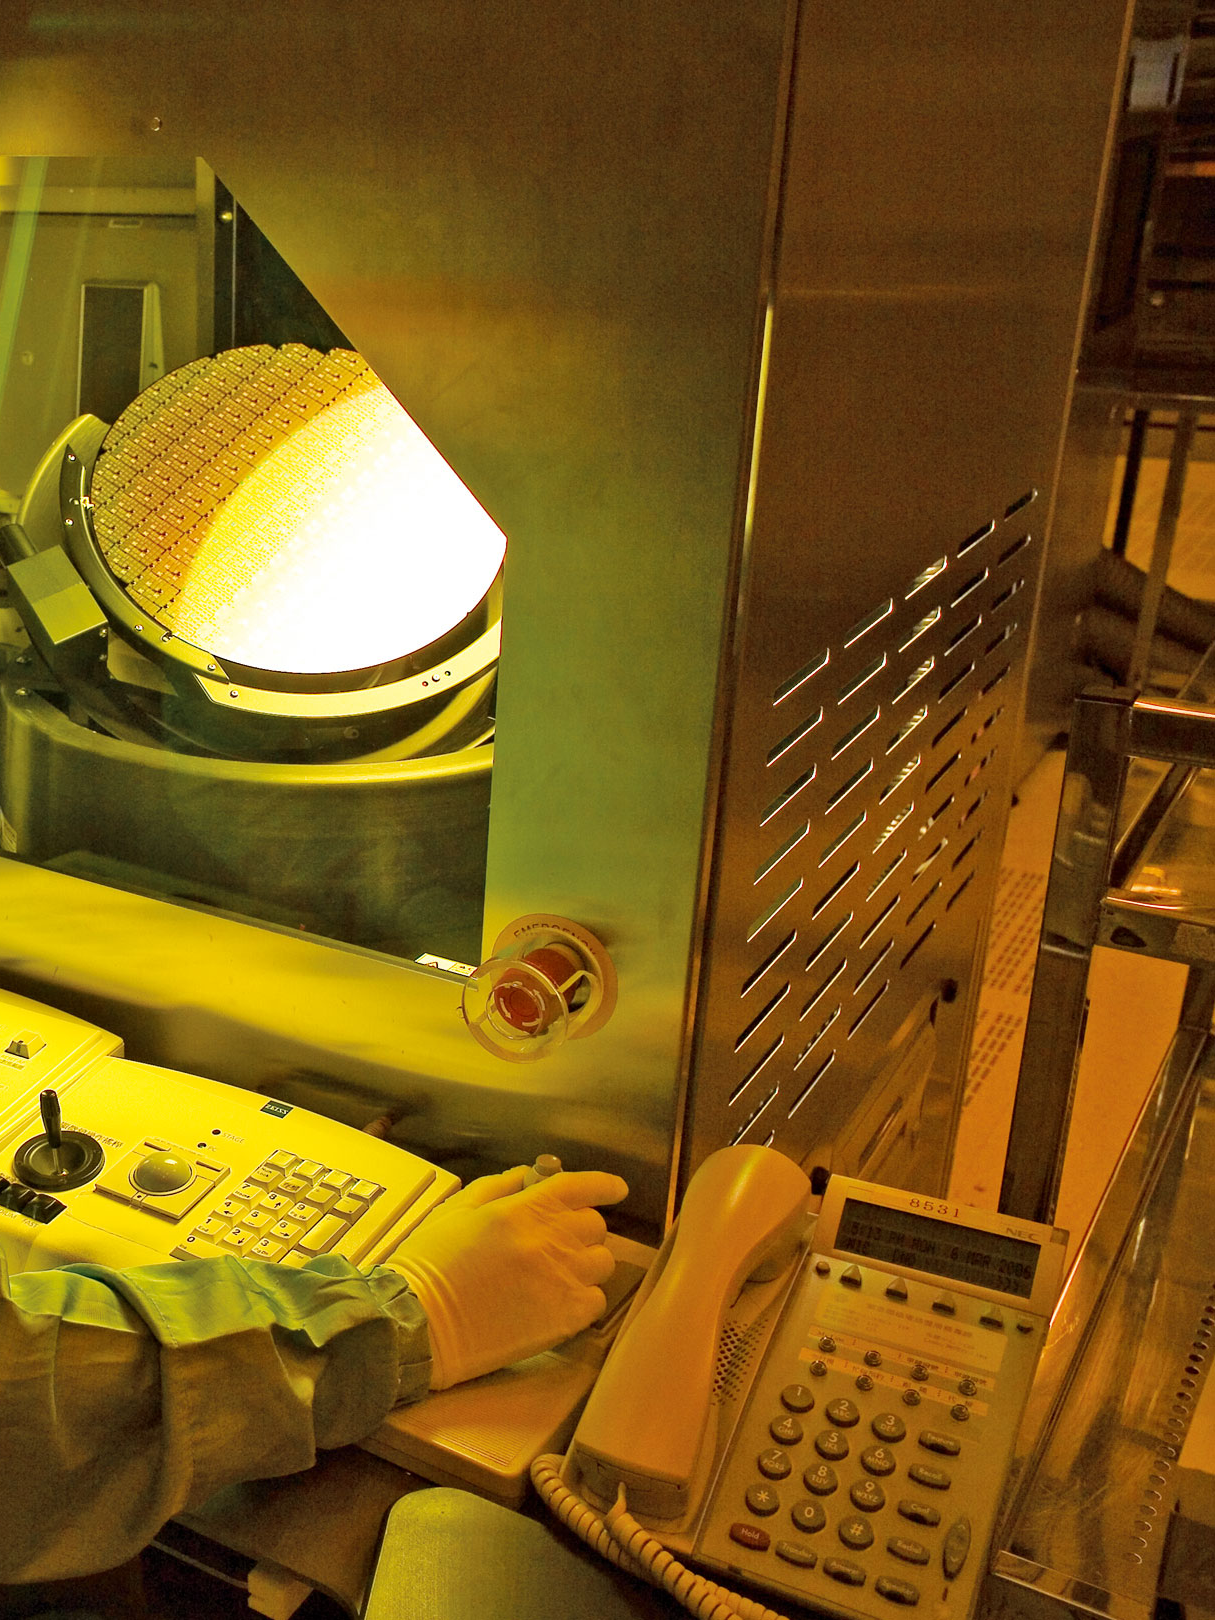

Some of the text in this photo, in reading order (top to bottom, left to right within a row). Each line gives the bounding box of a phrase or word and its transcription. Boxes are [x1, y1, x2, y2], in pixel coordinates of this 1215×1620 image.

[265, 1104, 289, 1115] ZEISS
[222, 1132, 246, 1144] STAGE
[207, 1145, 217, 1153] PC
[909, 1198, 960, 1218] 8531
[22, 1218, 39, 1229] FAST
[279, 1221, 288, 1229] 6
[232, 1228, 241, 1236] 2
[1005, 1227, 1040, 1242] NEC
[260, 1239, 269, 1247] 3
[797, 1386, 802, 1396] 1
[839, 1400, 849, 1411] 2
[832, 1409, 851, 1418] ABC
[783, 1418, 793, 1428] 4
[885, 1415, 895, 1425] 3
[777, 1426, 794, 1435] GHI
[879, 1423, 897, 1432] DEF
[828, 1432, 839, 1443] 5
[772, 1450, 782, 1460] 7
[875, 1448, 885, 1458] 6
[866, 1455, 890, 1467] MNO
[817, 1465, 828, 1477] 8
[811, 1474, 829, 1485] TUV
[865, 1481, 875, 1492] 9
[856, 1490, 878, 1502] WXYZ
[804, 1506, 814, 1518] 0
[741, 1528, 760, 1540] Hold
